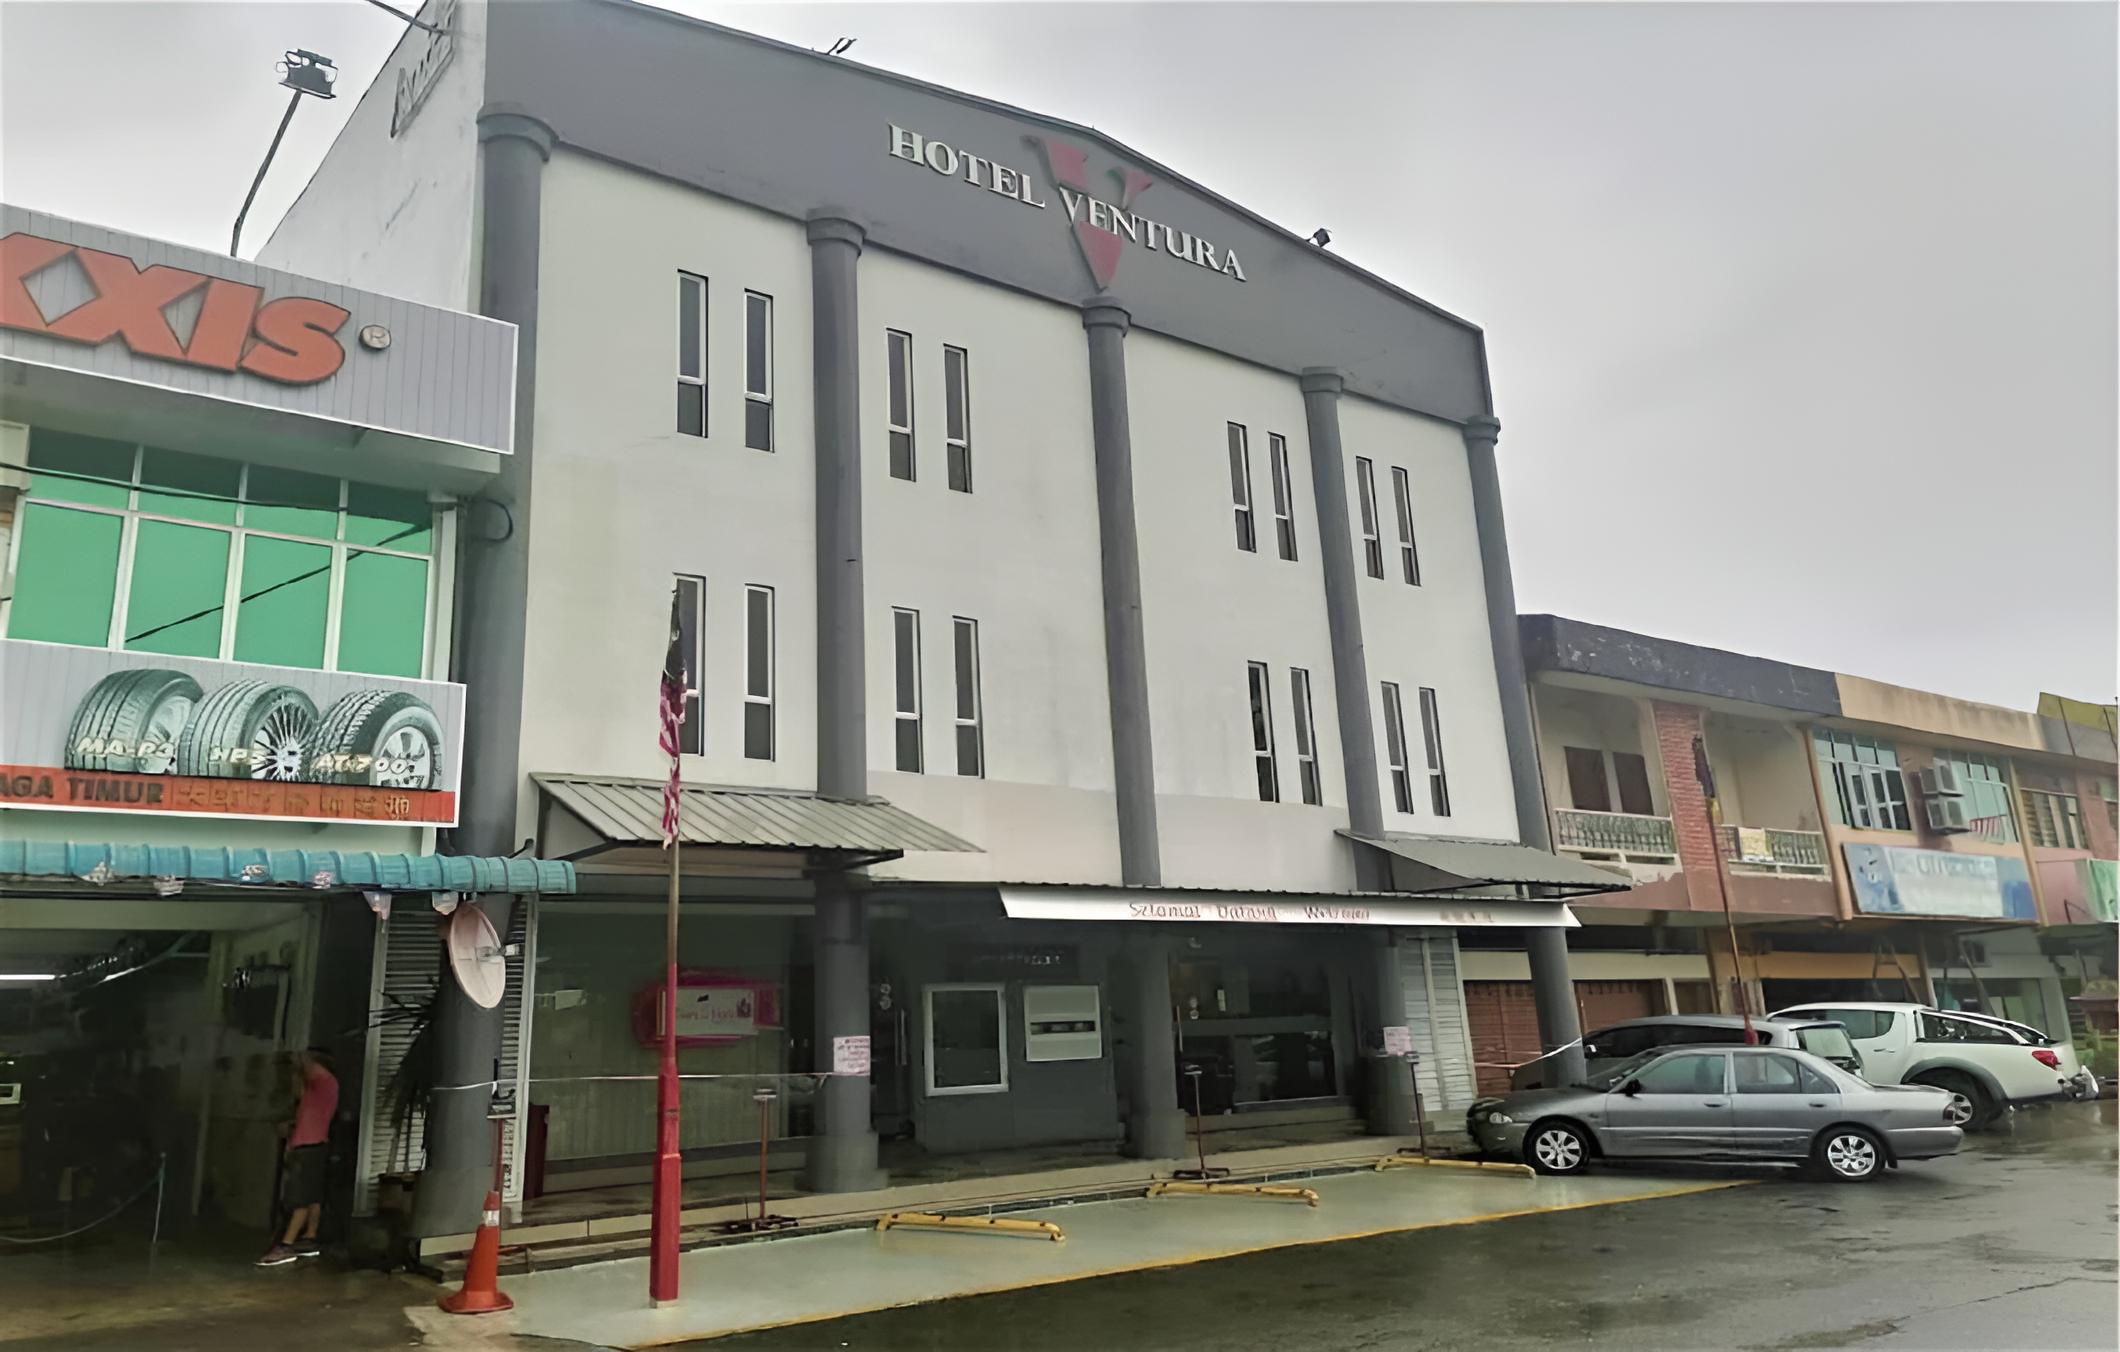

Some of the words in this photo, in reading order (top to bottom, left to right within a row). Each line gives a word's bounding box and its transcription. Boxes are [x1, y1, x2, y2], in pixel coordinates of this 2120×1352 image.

[887, 122, 1046, 208] HOTEL
[1057, 186, 1247, 281] VENTURA
[66, 775, 164, 804] TIMUR
